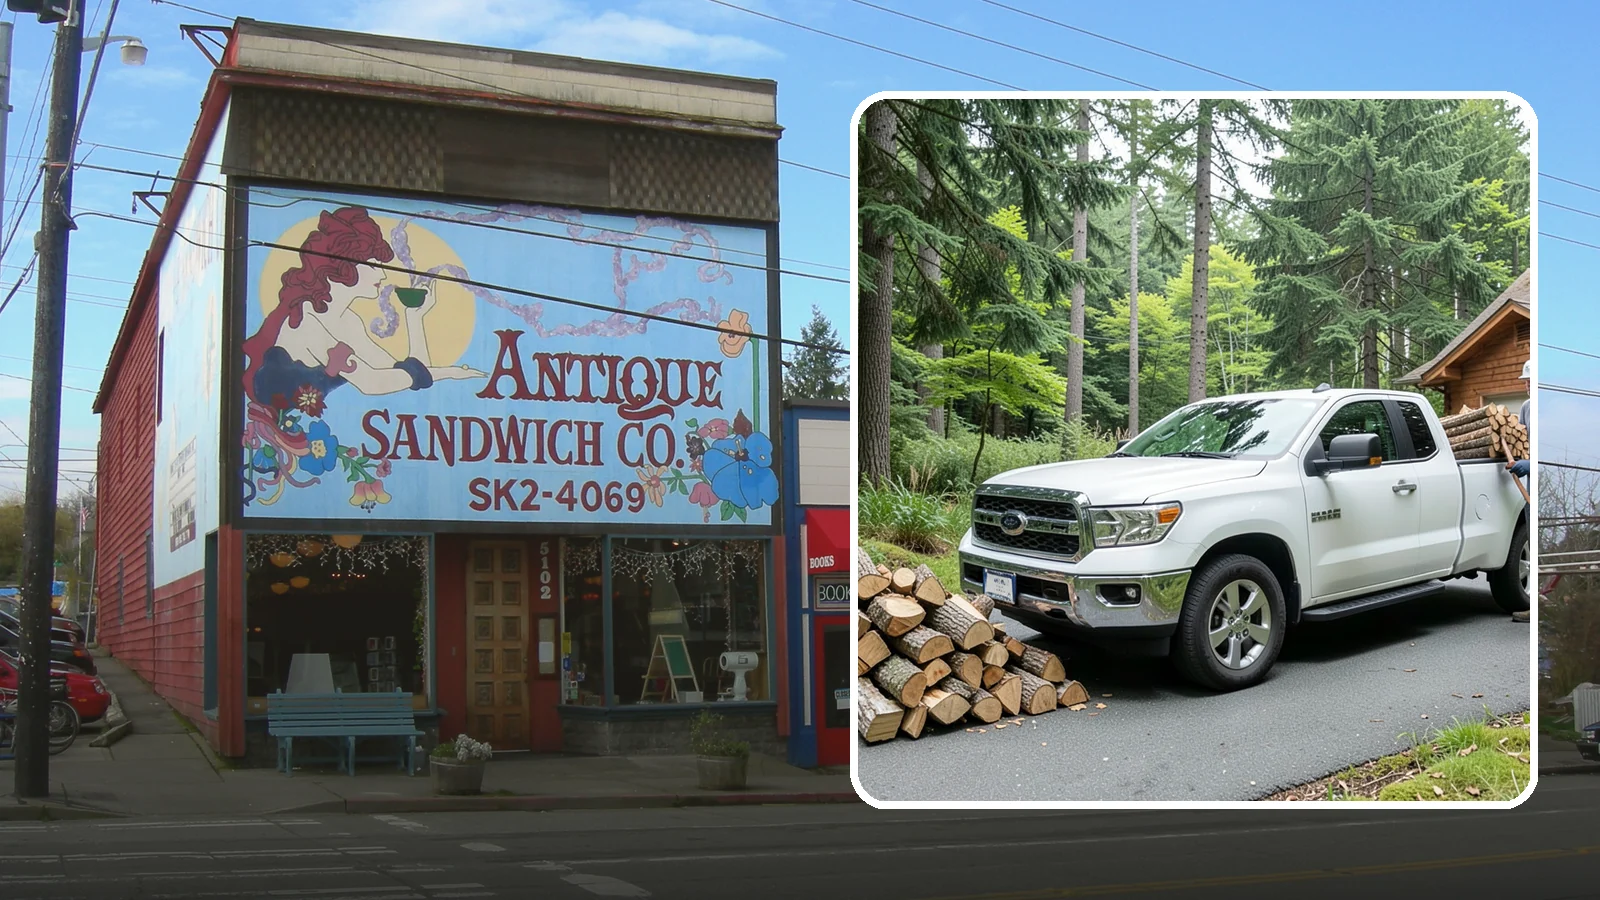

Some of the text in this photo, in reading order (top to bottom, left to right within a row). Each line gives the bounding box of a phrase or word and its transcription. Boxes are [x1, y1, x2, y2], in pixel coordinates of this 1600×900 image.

[476, 329, 724, 420] ANTIQUE
[361, 408, 685, 468] SANDWICH CO.
[468, 477, 646, 513] SK2-4069
[539, 541, 552, 600] 5102
[809, 554, 835, 568] BOOKS
